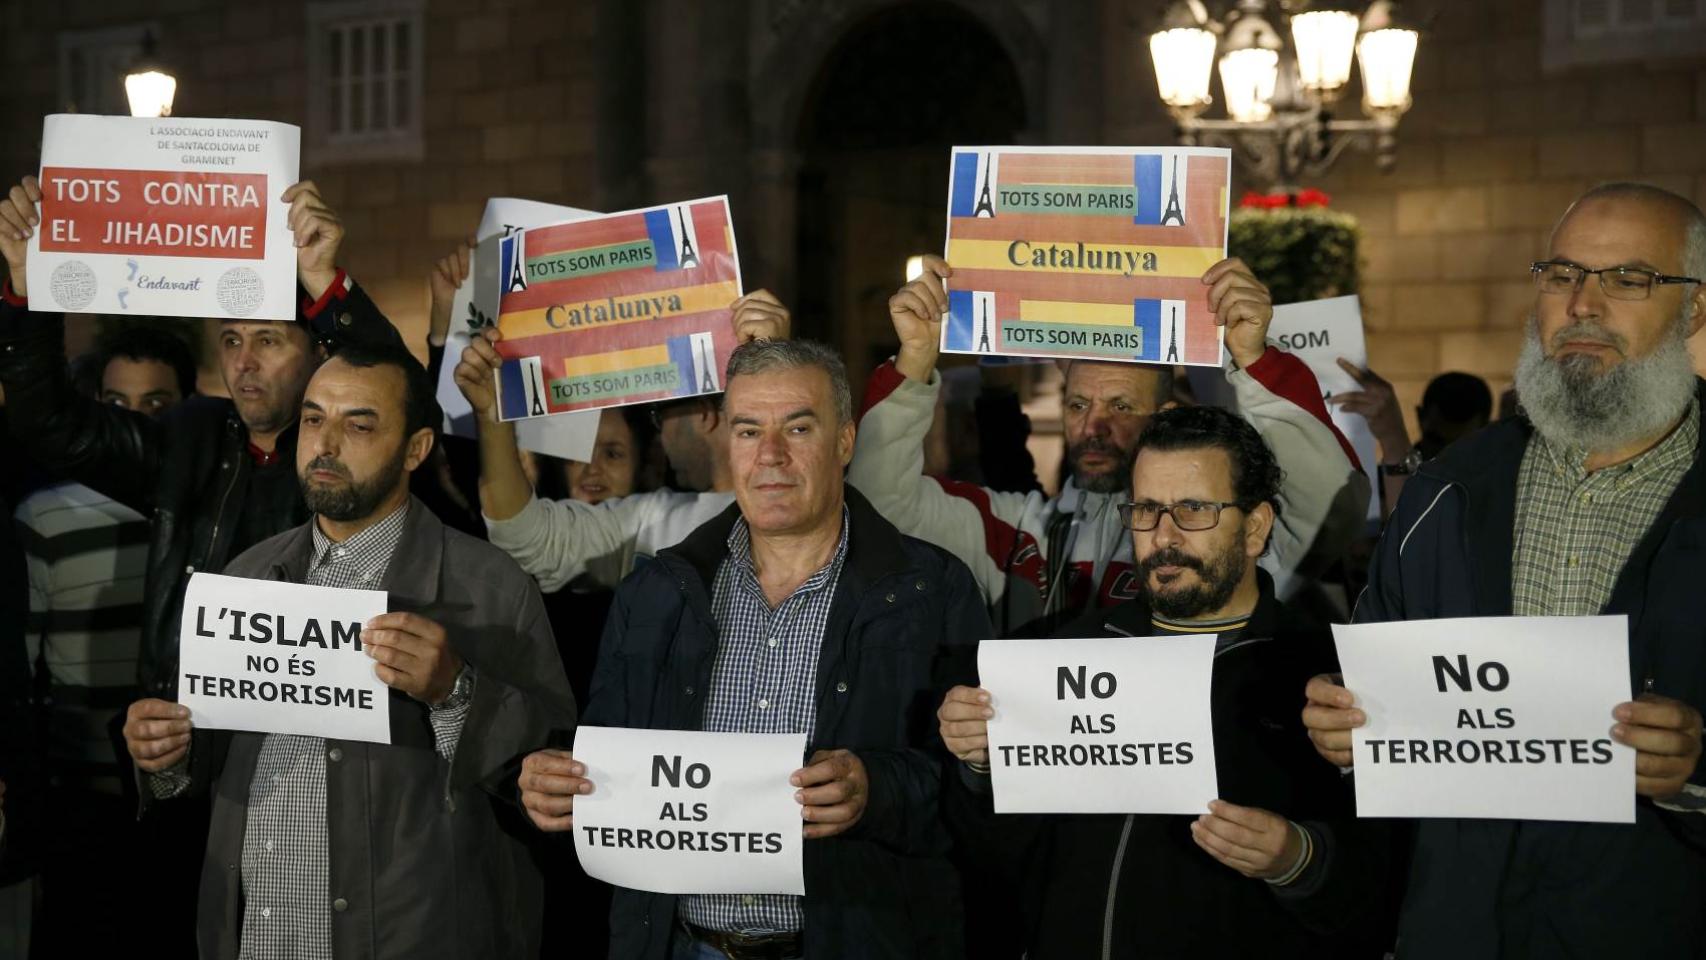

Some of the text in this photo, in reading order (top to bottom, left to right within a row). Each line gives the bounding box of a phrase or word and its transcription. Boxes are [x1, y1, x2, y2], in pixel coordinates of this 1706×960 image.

[158, 141, 260, 152] DE SANTACOLOMA DE
[217, 129, 269, 139] ENDAVANT
[181, 155, 235, 165] GRAMENET
[52, 178, 259, 208] TOTS CONTRA
[1000, 190, 1134, 209] TOTS SOM PARIS
[52, 219, 254, 249] EL JIHADISME
[528, 246, 652, 277] TOTS SOM PARIS
[1008, 240, 1158, 276] Catalunya
[137, 276, 202, 291] Endavant
[545, 293, 682, 329] Catalunya
[1004, 328, 1138, 349] TOTS SOM PARIS
[1278, 329, 1330, 350] SOM
[552, 370, 676, 399] TOTS SOM PARIS
[247, 654, 316, 676] NO ÉS
[1432, 654, 1510, 692] No
[185, 674, 373, 710] TERRORISME
[1057, 666, 1117, 700] No
[1071, 714, 1116, 734] ALS
[1457, 708, 1515, 729] ALS
[999, 742, 1193, 766] TERRORISTES
[1365, 739, 1613, 765] TERRORISTES
[651, 755, 711, 789] No
[659, 803, 708, 822] ALS
[583, 826, 782, 853] TERRORISTES
